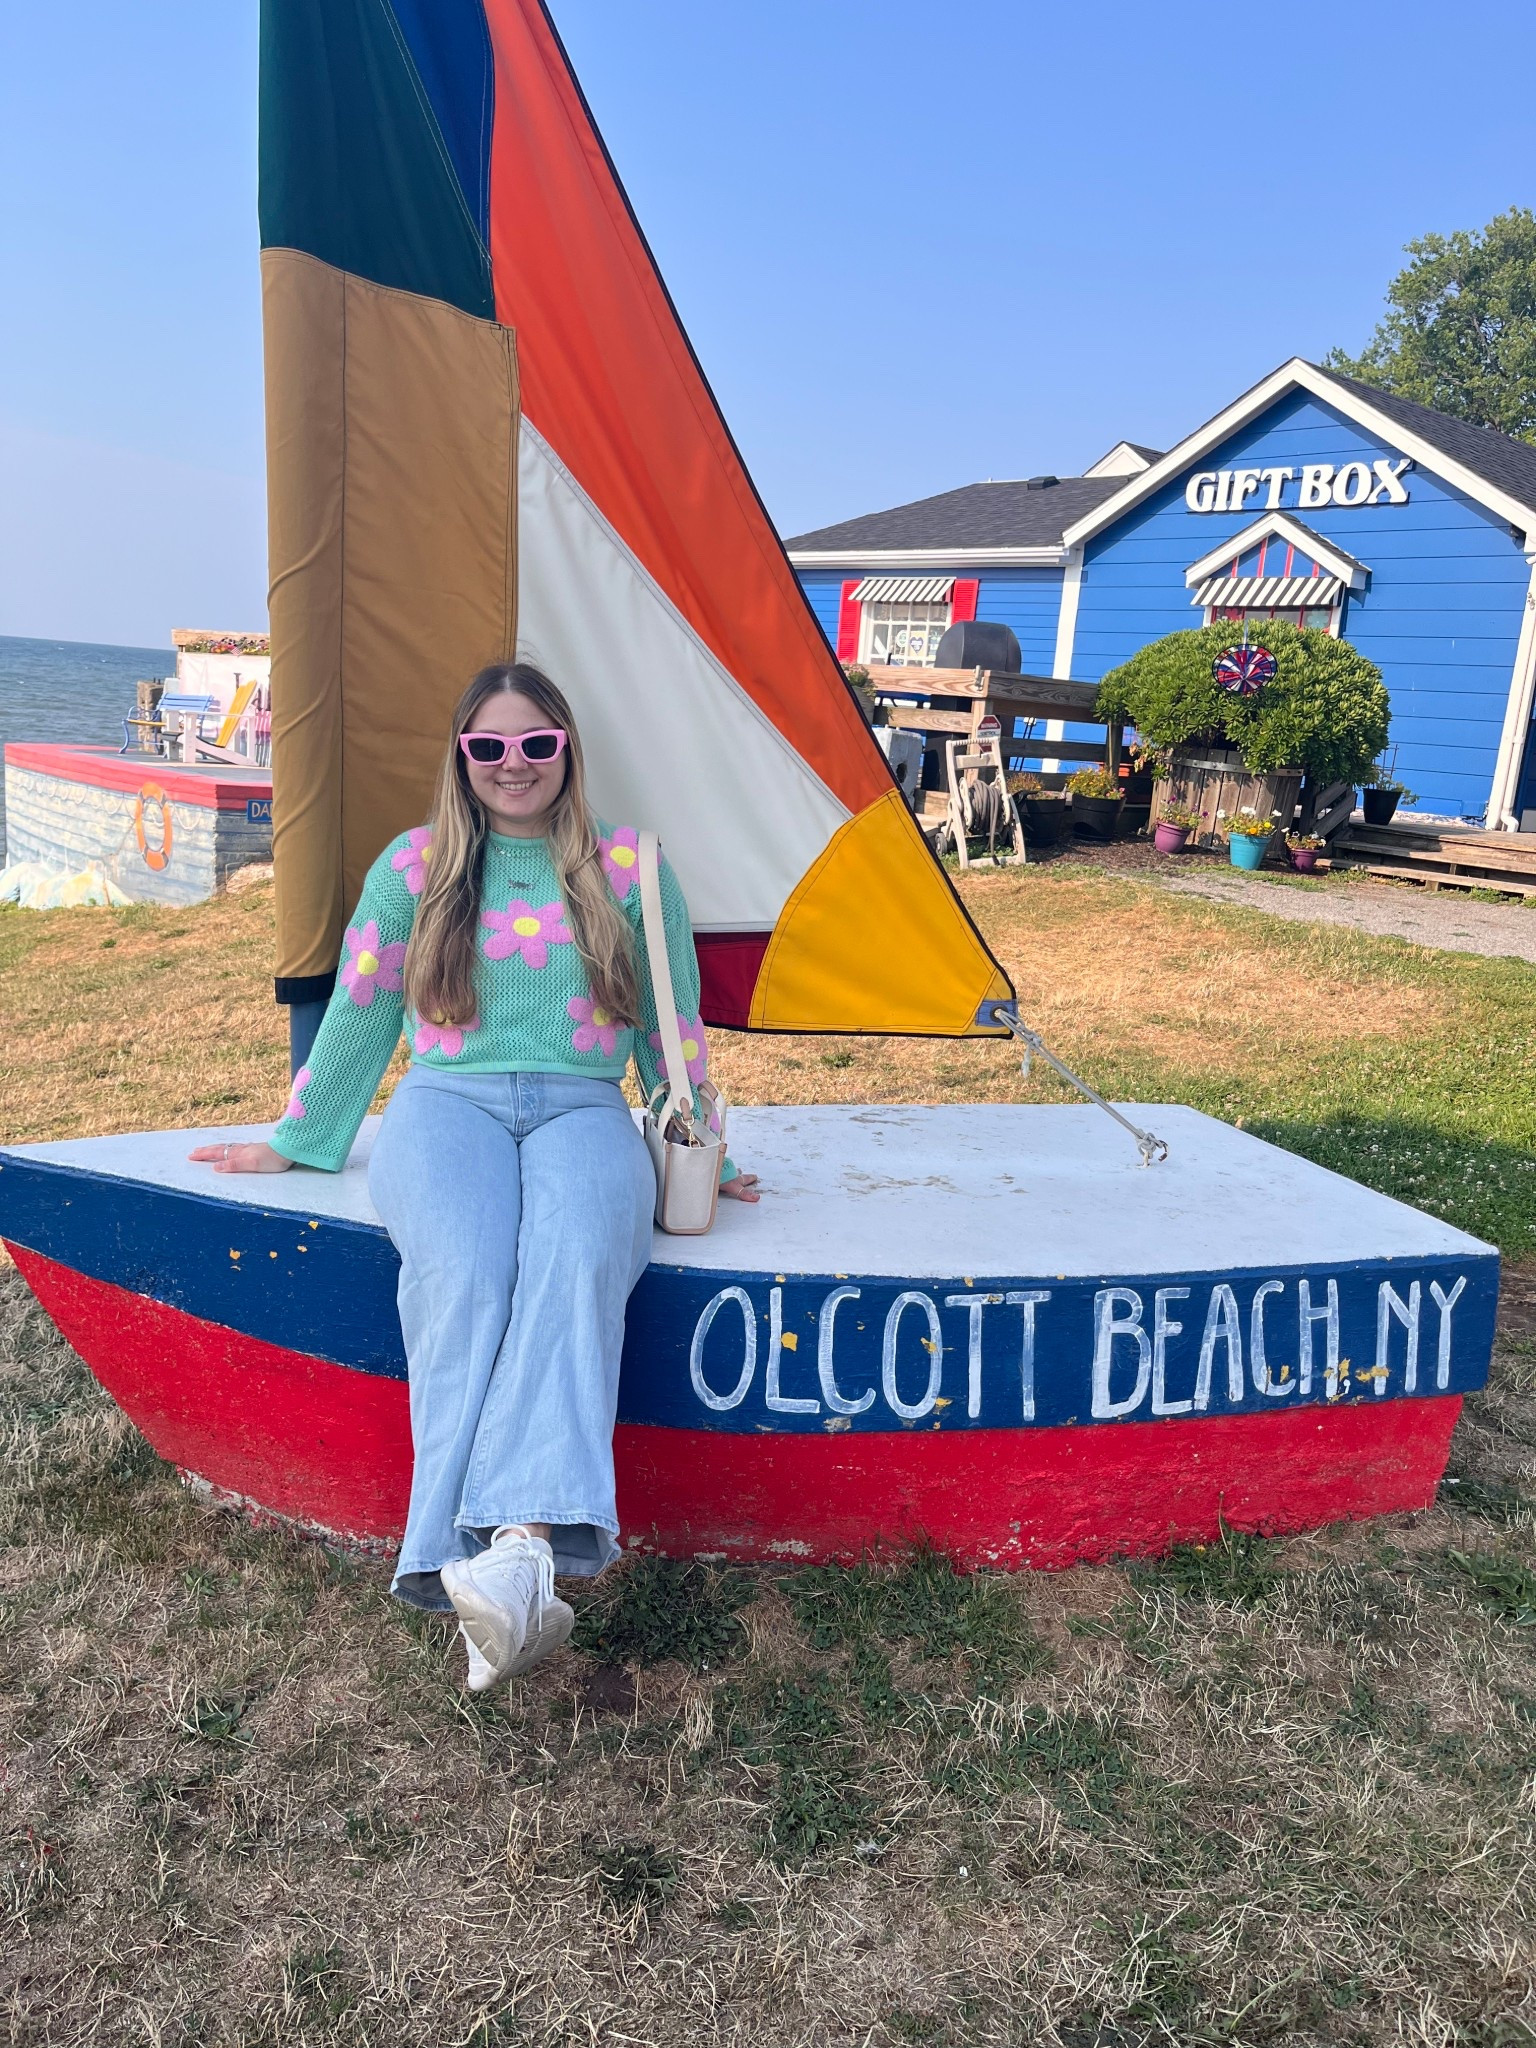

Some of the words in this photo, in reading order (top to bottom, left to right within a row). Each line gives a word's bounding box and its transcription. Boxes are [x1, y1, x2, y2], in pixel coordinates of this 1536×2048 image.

[1185, 466, 1293, 512] GIFT
[1299, 458, 1412, 508] BOX
[690, 1286, 1052, 1421] OLCOTT
[1374, 1276, 1467, 1395] NY
